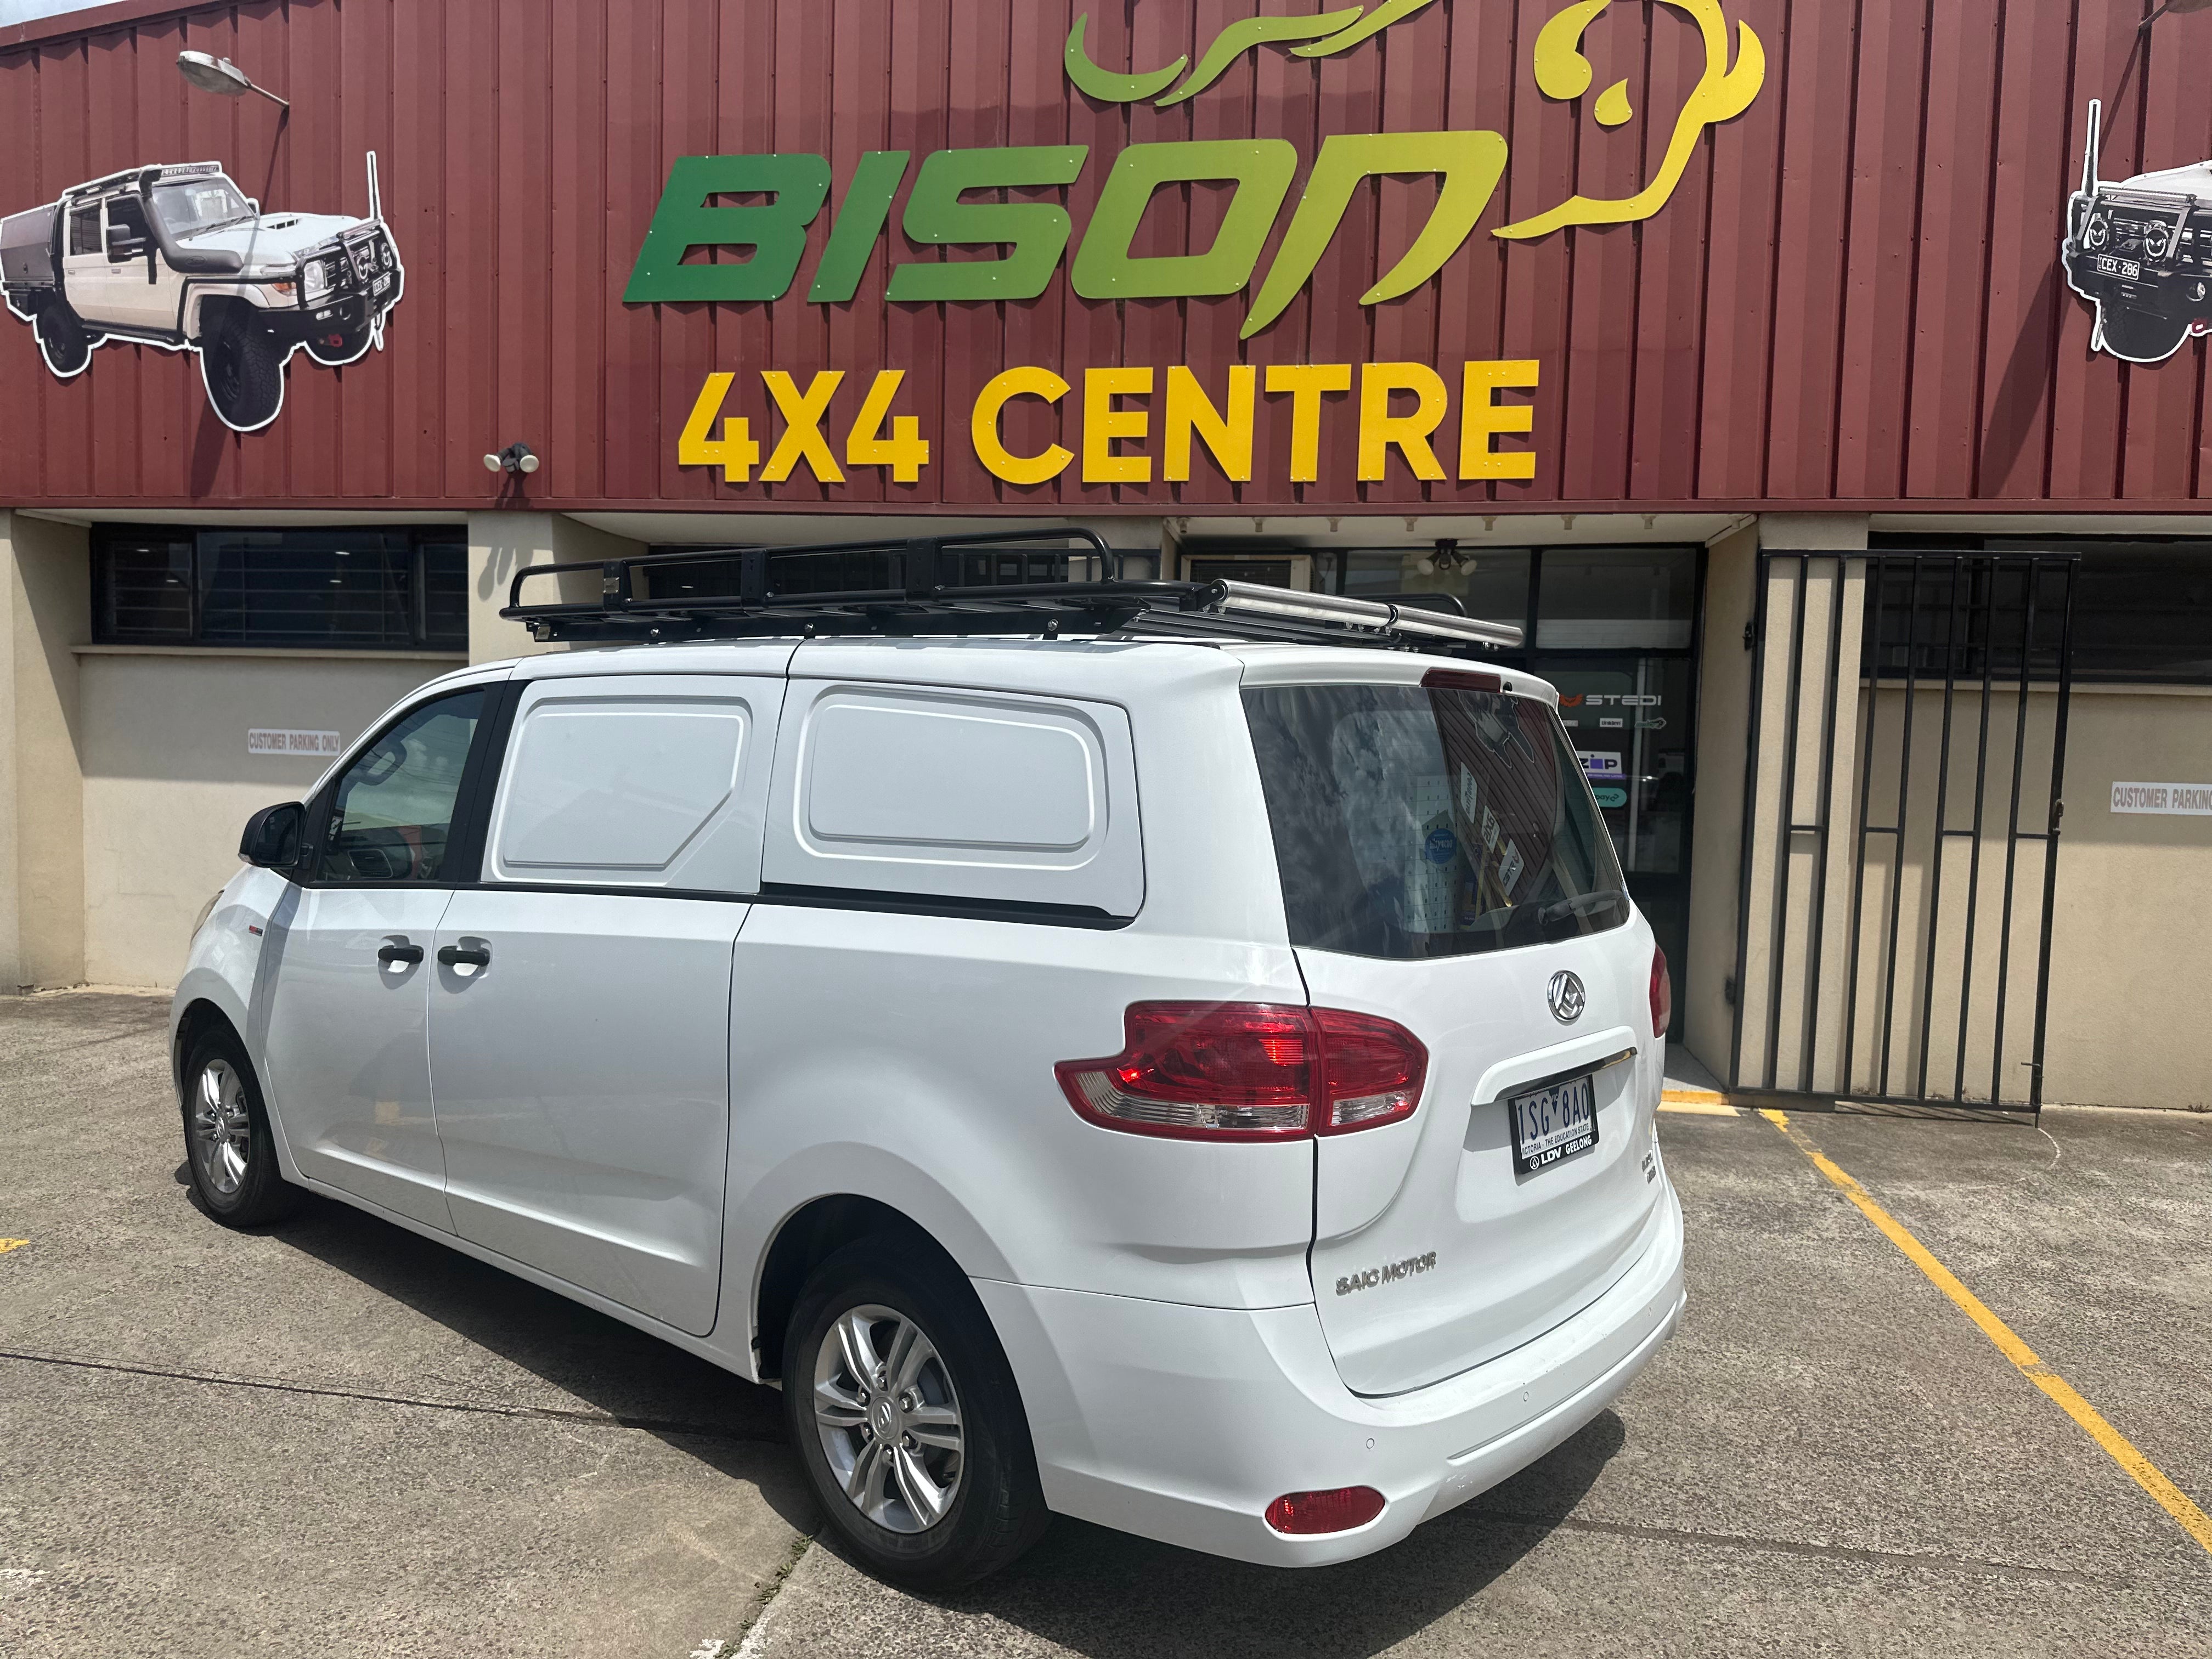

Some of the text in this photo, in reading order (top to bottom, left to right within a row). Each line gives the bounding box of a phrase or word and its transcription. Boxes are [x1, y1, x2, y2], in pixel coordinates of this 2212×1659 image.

[622, 130, 1508, 340] BISON
[679, 360, 1539, 484] 4X4 CENTRE
[1585, 695, 1662, 706] STEDI
[249, 732, 340, 752] CUSTOMER PARKING ONLY
[2113, 787, 2168, 809] CUSTOMER
[1517, 1097, 1549, 1145] 1SG
[1545, 1137, 1554, 1147] THE
[1554, 1128, 1577, 1143] EDUCATION
[1578, 1123, 1589, 1135] STATE
[1541, 1135, 1592, 1165] LDV GEELONG
[1336, 1251, 1437, 1296] SAIC MOTOR
